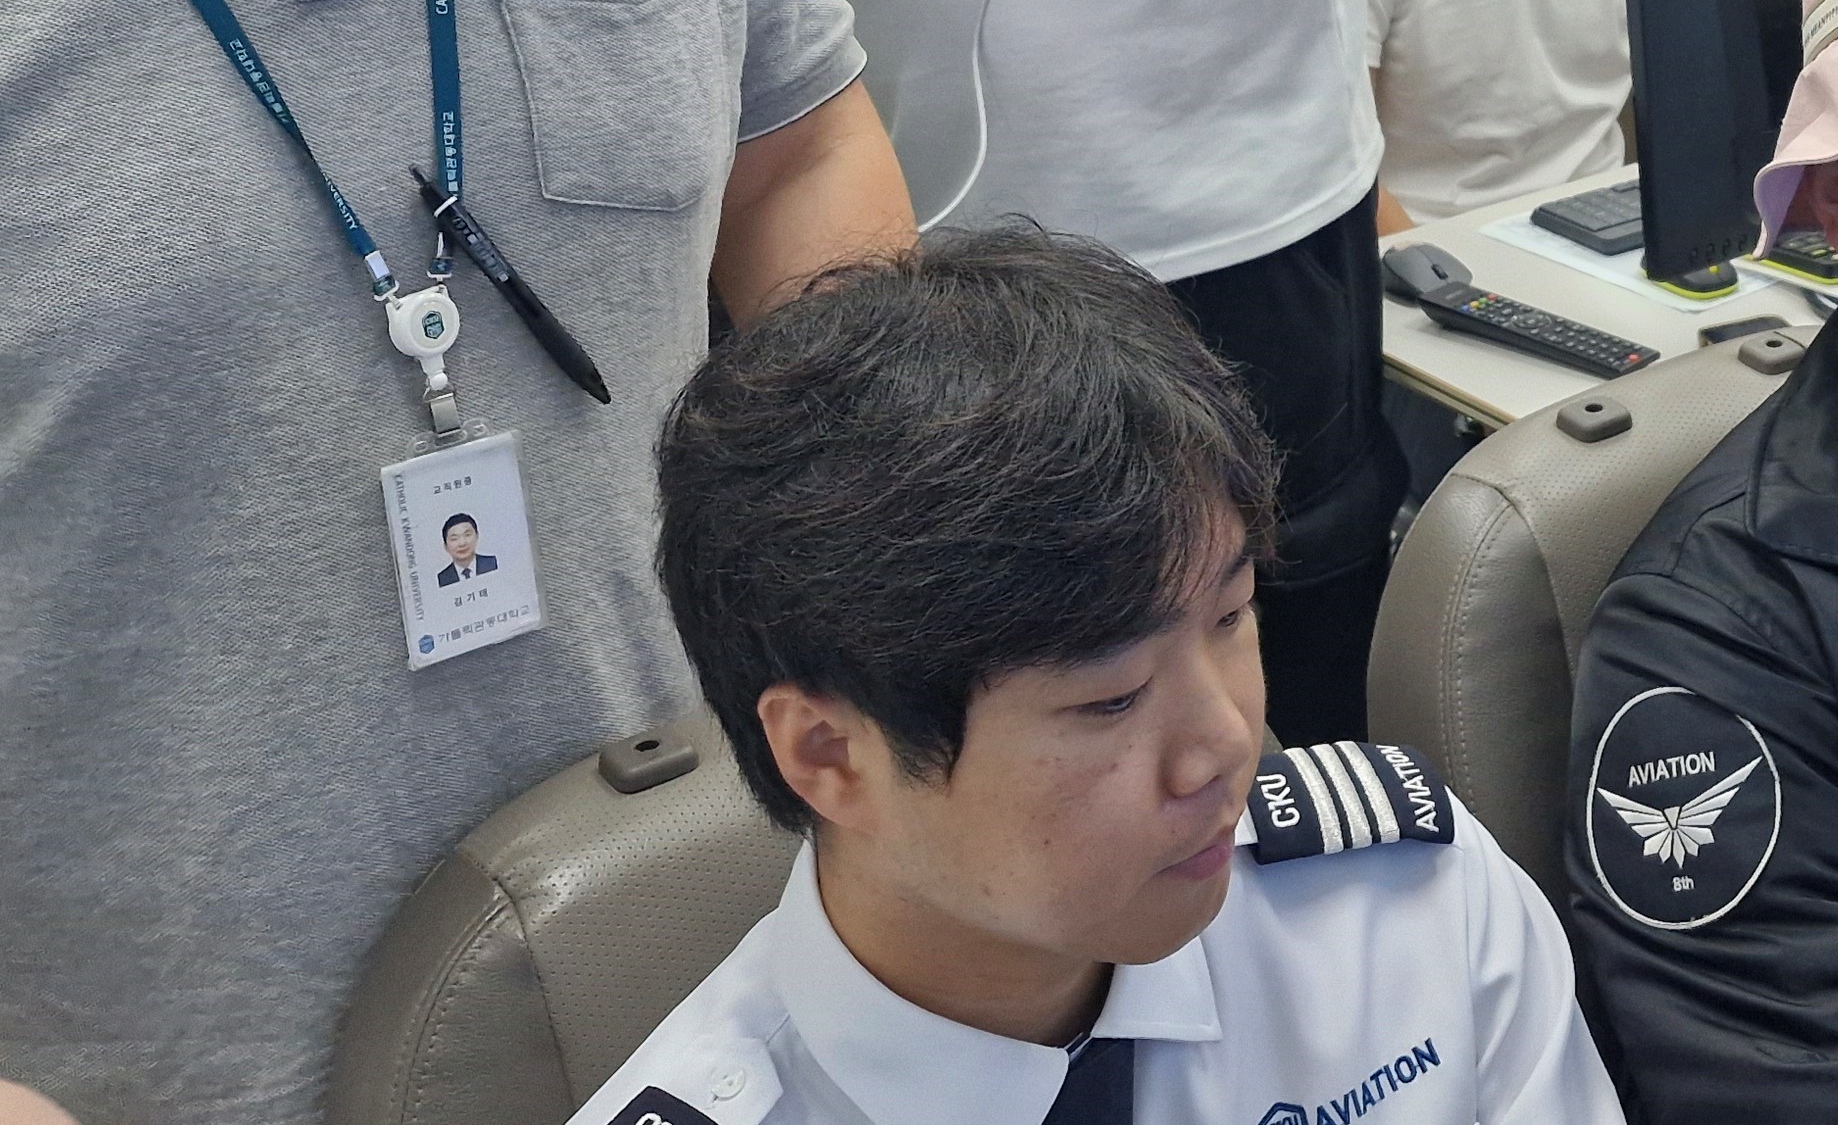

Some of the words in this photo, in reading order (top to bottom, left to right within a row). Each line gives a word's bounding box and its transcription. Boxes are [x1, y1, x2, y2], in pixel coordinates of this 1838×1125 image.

[442, 111, 459, 193] 톨릭관동대학교
[322, 172, 358, 231] IVERSITY
[1256, 773, 1300, 828] CKU
[1376, 744, 1440, 833] AVIATION
[1628, 751, 1716, 788] AVIATION
[1671, 874, 1695, 893] 8th
[1316, 1037, 1442, 1125] AVIATION
